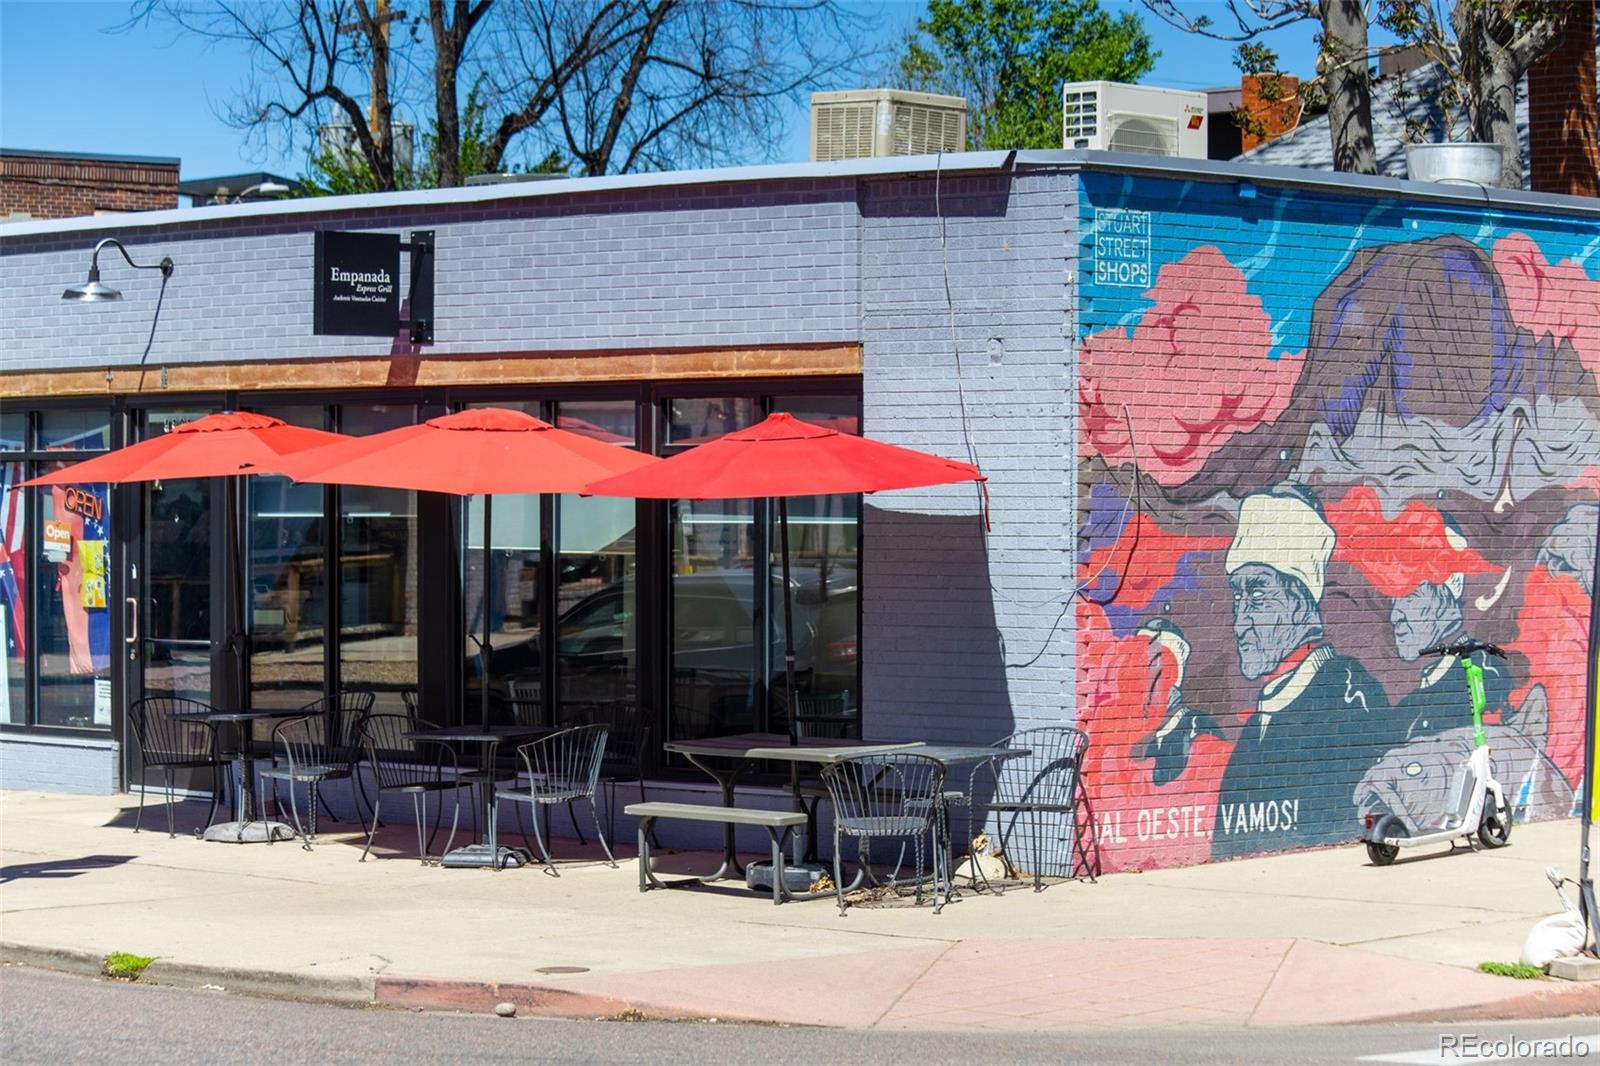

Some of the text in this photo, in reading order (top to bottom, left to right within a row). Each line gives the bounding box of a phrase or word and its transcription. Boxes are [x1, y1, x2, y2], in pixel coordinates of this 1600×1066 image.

[1098, 212, 1148, 235] STUART
[1098, 236, 1148, 259] STREET
[330, 266, 391, 287] Empanada
[1098, 261, 1149, 284] SHOPS
[356, 284, 393, 295] Express Grill
[64, 487, 103, 521] OPEN
[46, 525, 71, 541] Open
[1136, 804, 1214, 843] OESTE,
[1221, 799, 1300, 836] VAMOS!
